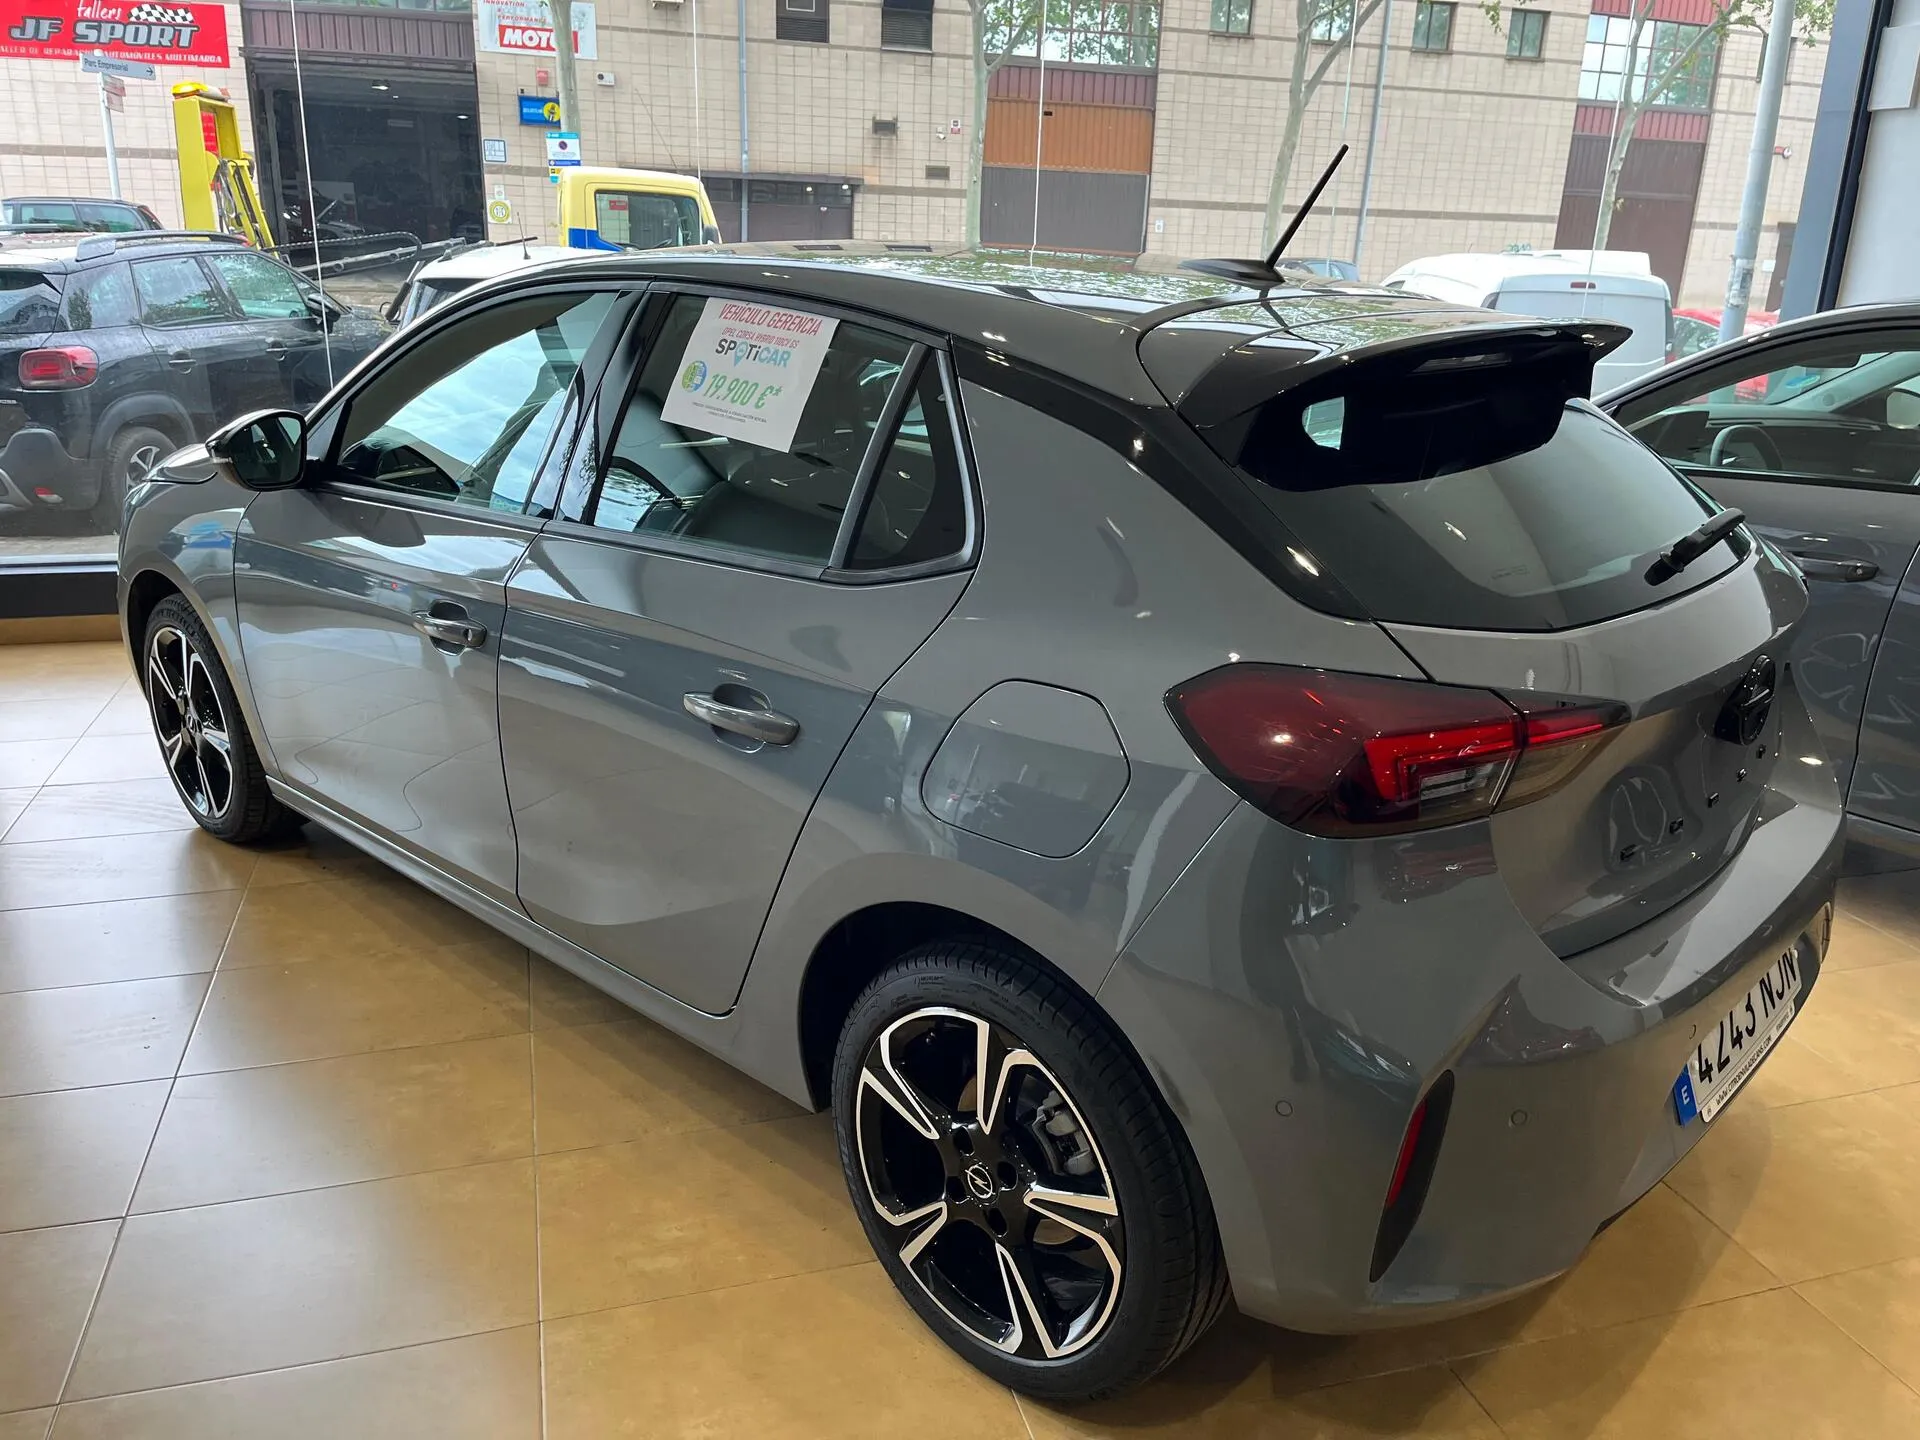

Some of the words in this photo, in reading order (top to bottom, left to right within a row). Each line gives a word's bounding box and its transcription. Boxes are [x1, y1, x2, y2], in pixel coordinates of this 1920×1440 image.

[77, 0, 122, 20] tallers
[9, 16, 64, 41] JF
[73, 20, 199, 48] SPORT
[503, 28, 557, 48] MOT
[767, 311, 823, 336] GERENCIA
[703, 373, 760, 406] 19.900
[1697, 992, 1756, 1084] 4243
[1759, 947, 1797, 1018] NJN
[1681, 1085, 1690, 1105] E
